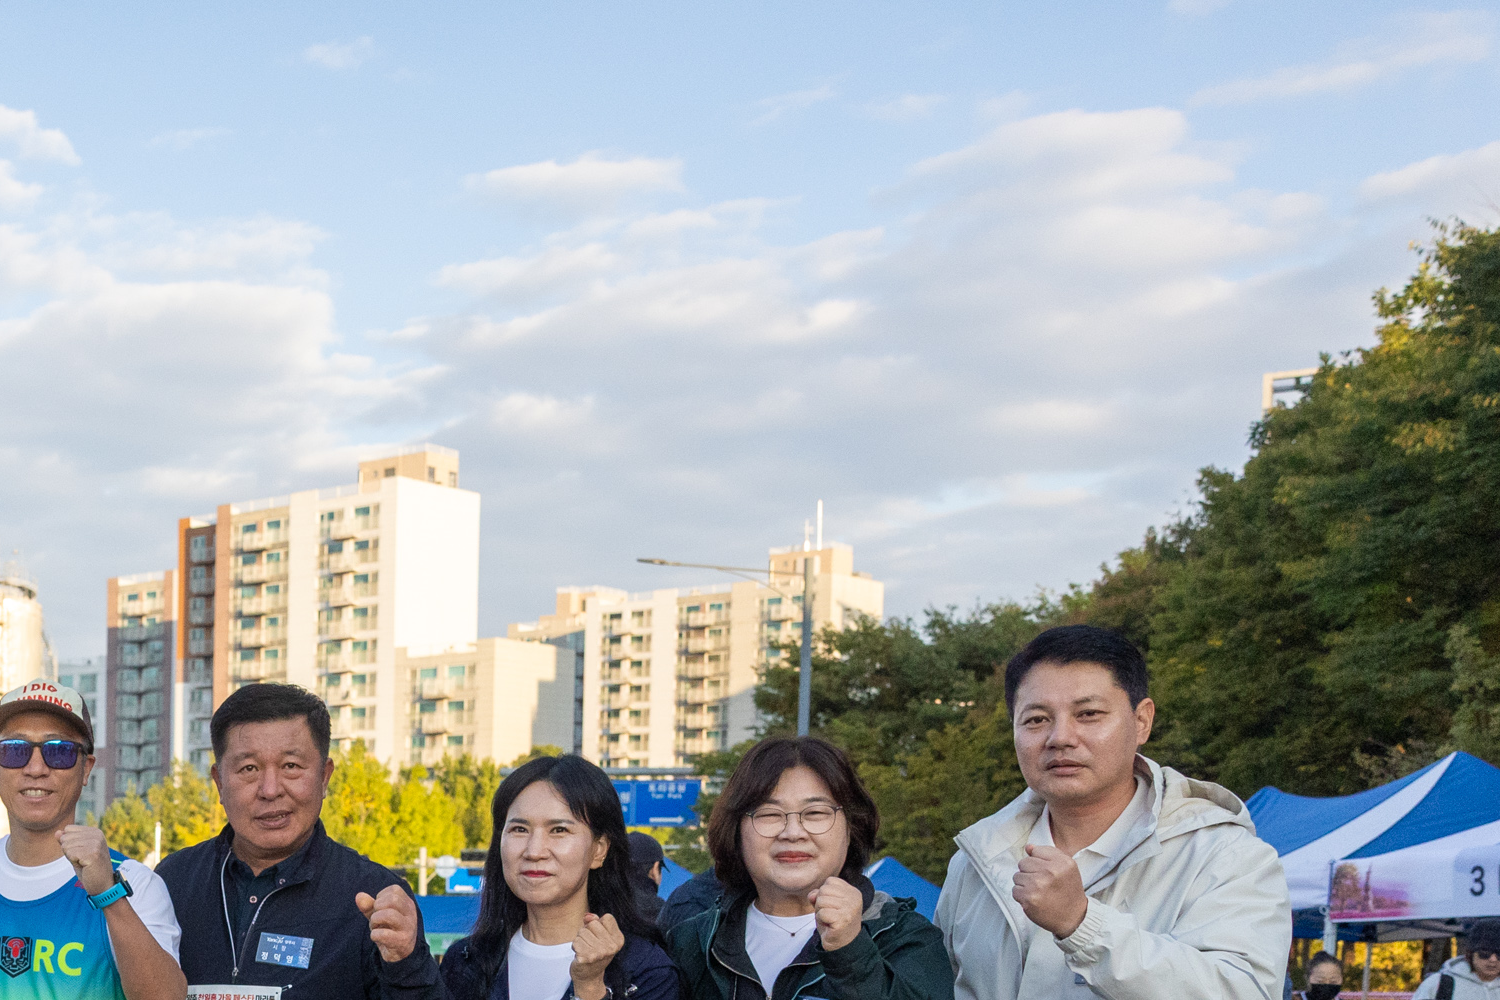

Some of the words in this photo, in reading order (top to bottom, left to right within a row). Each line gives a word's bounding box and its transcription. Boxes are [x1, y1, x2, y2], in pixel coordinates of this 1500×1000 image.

[23, 685, 27, 693] I
[31, 683, 57, 692] DIG
[17, 694, 72, 711] NNING
[1470, 865, 1485, 897] 3
[33, 938, 85, 977] RC
